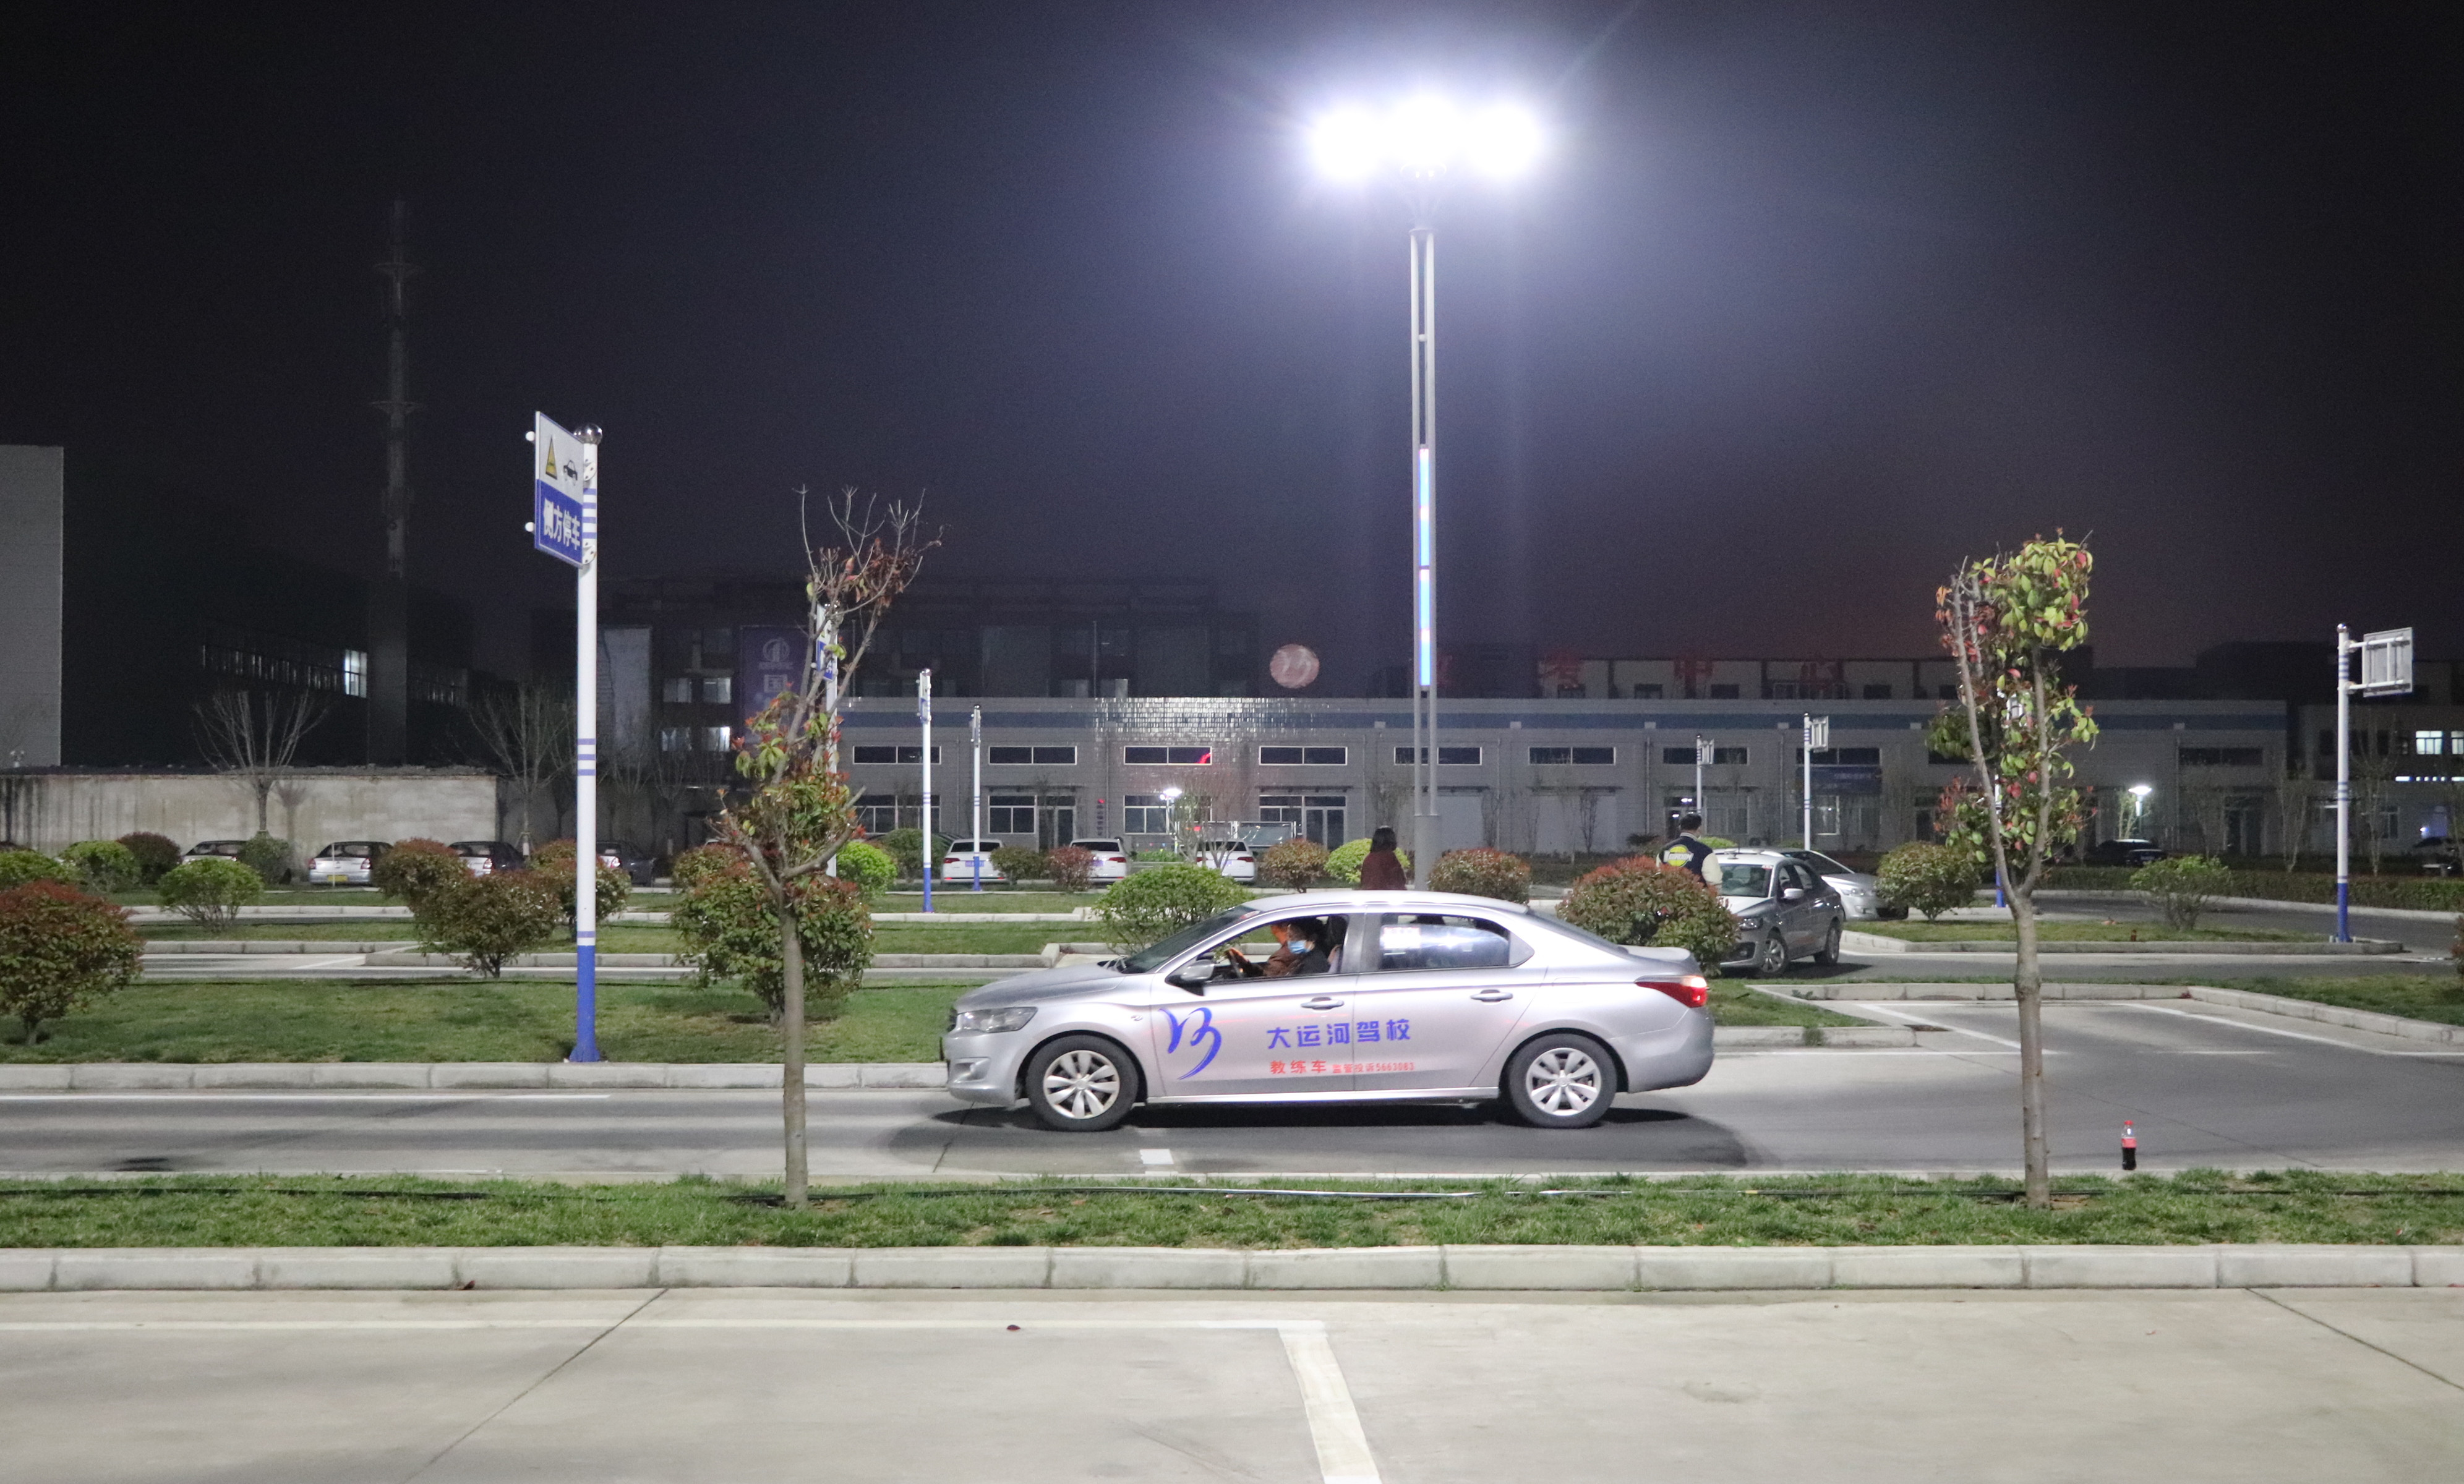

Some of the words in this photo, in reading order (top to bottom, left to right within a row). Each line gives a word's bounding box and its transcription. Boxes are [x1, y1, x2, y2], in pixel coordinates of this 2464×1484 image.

[1267, 1018, 1411, 1049] 大运河驾校
[1270, 1059, 1327, 1075] 教练车
